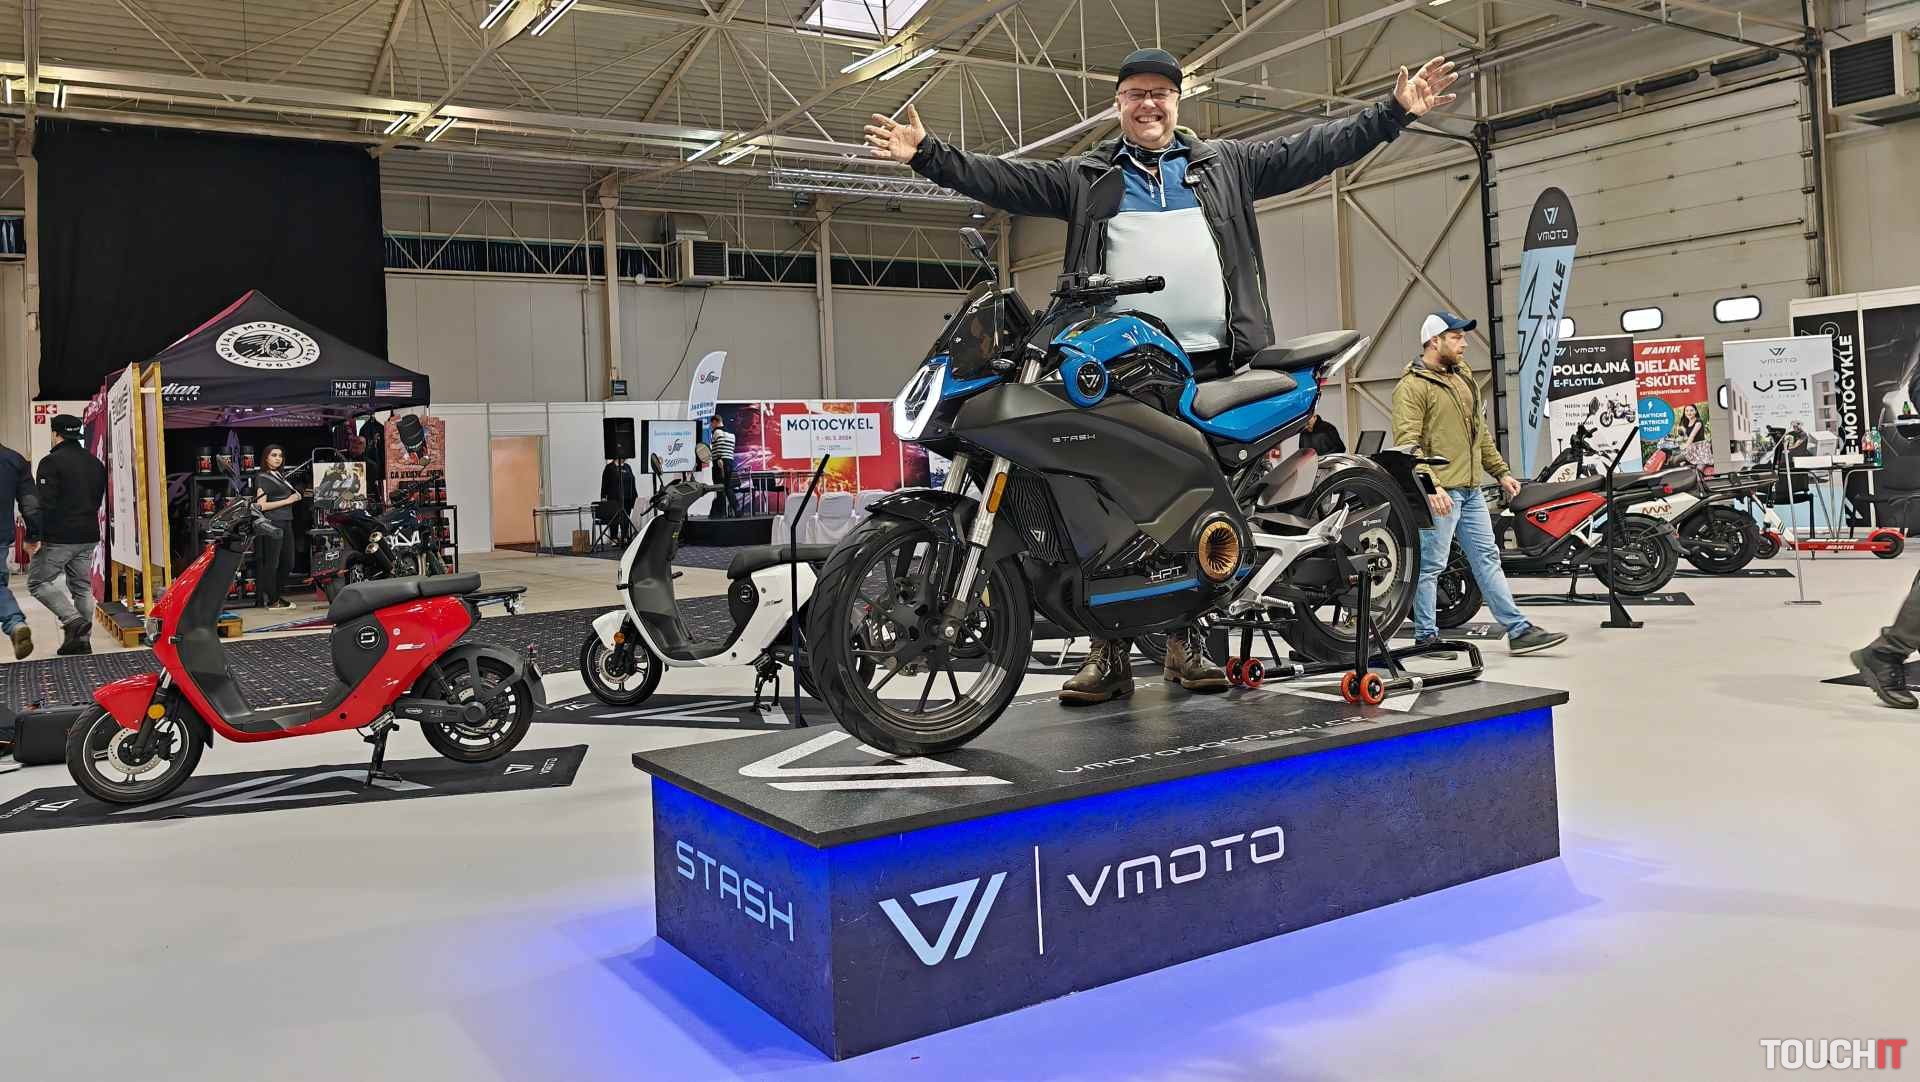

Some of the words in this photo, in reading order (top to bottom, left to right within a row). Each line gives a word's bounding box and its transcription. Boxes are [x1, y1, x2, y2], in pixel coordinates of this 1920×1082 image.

[1537, 229, 1568, 240] VMOTO
[243, 323, 316, 361] MOTORCYCLE
[1574, 346, 1606, 354] VMOTO
[1650, 345, 1681, 355] ANTIK
[1552, 358, 1630, 376] POLICAJNÁ
[1635, 355, 1701, 374] DIEĽANÉ
[161, 383, 200, 395] dian
[1553, 377, 1604, 388] E-FLOTILA
[1753, 378, 1807, 392] VS1
[1840, 334, 1860, 455] E-MOTOCYKLE
[787, 418, 874, 431] MOTOCYKEL
[1052, 434, 1096, 443] STASH
[1150, 565, 1182, 581] HPT
[1066, 825, 1286, 907] VMOTO
[676, 839, 795, 942] STASH
